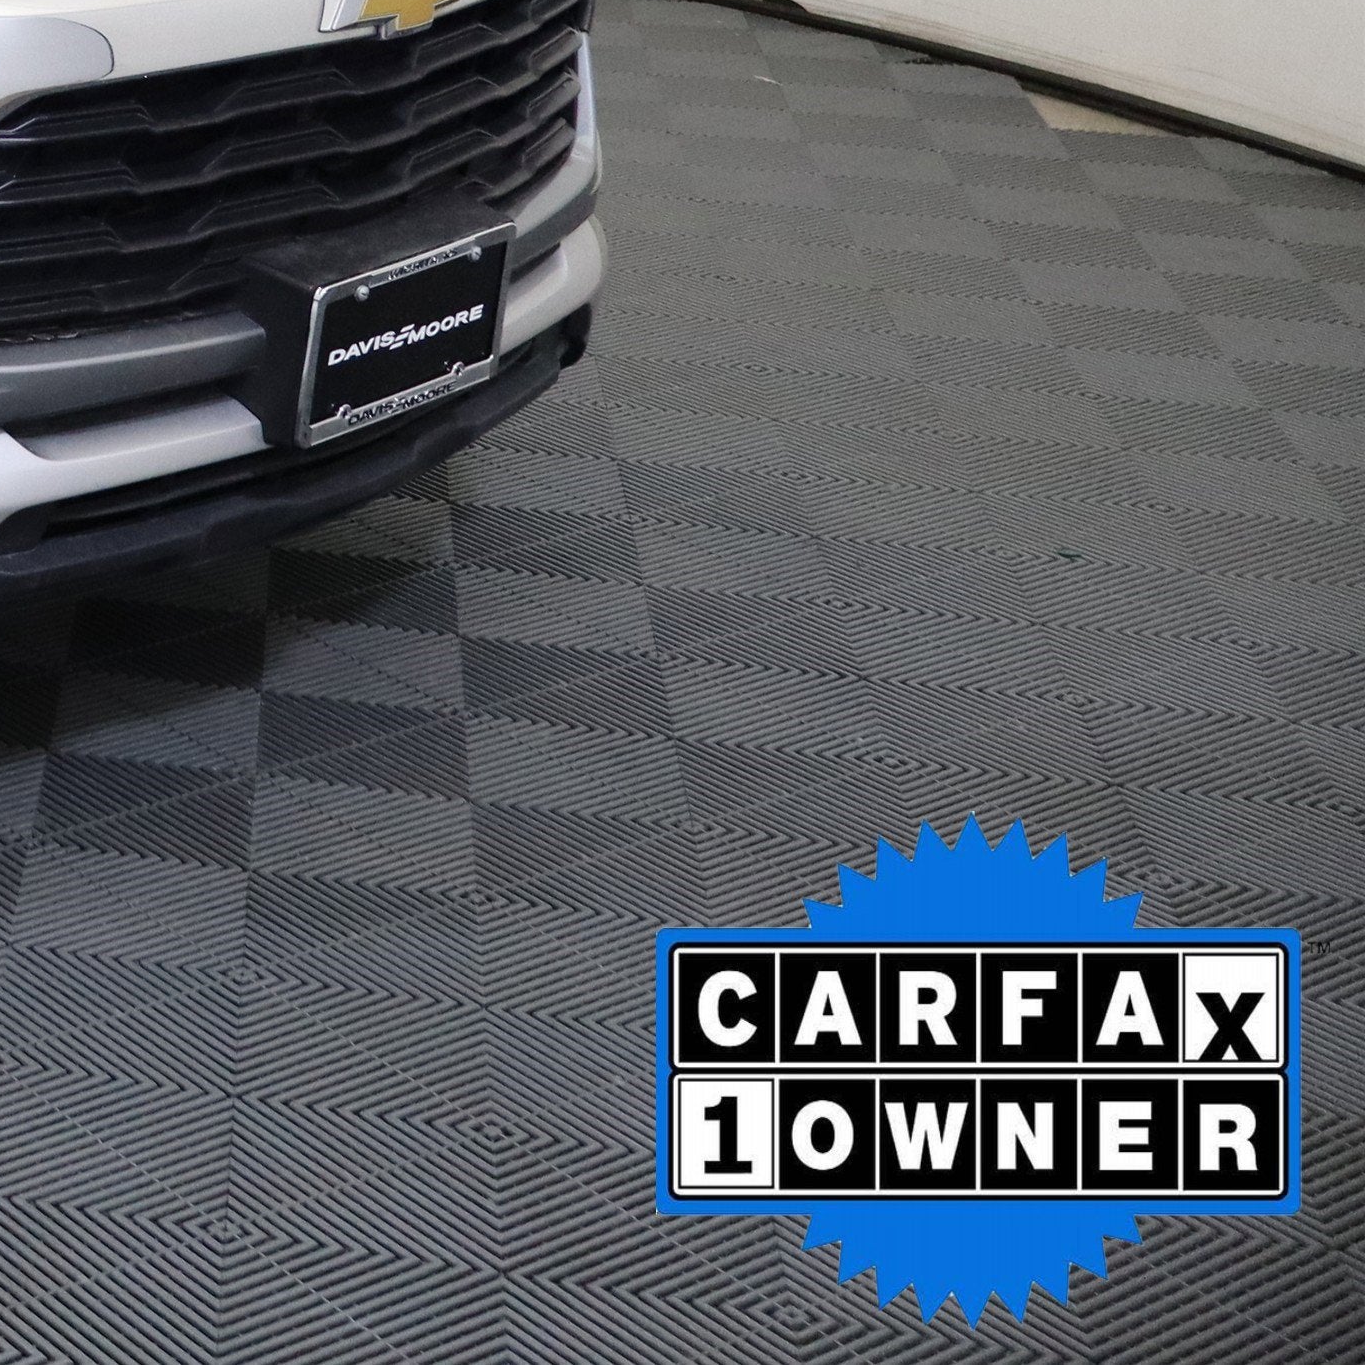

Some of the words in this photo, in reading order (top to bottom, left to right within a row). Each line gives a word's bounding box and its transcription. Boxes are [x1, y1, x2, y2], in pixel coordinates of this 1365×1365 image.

[328, 331, 396, 366] DAVIS
[407, 304, 484, 345] MOORE
[349, 401, 395, 425] DAVIS
[402, 381, 457, 409] MOORE
